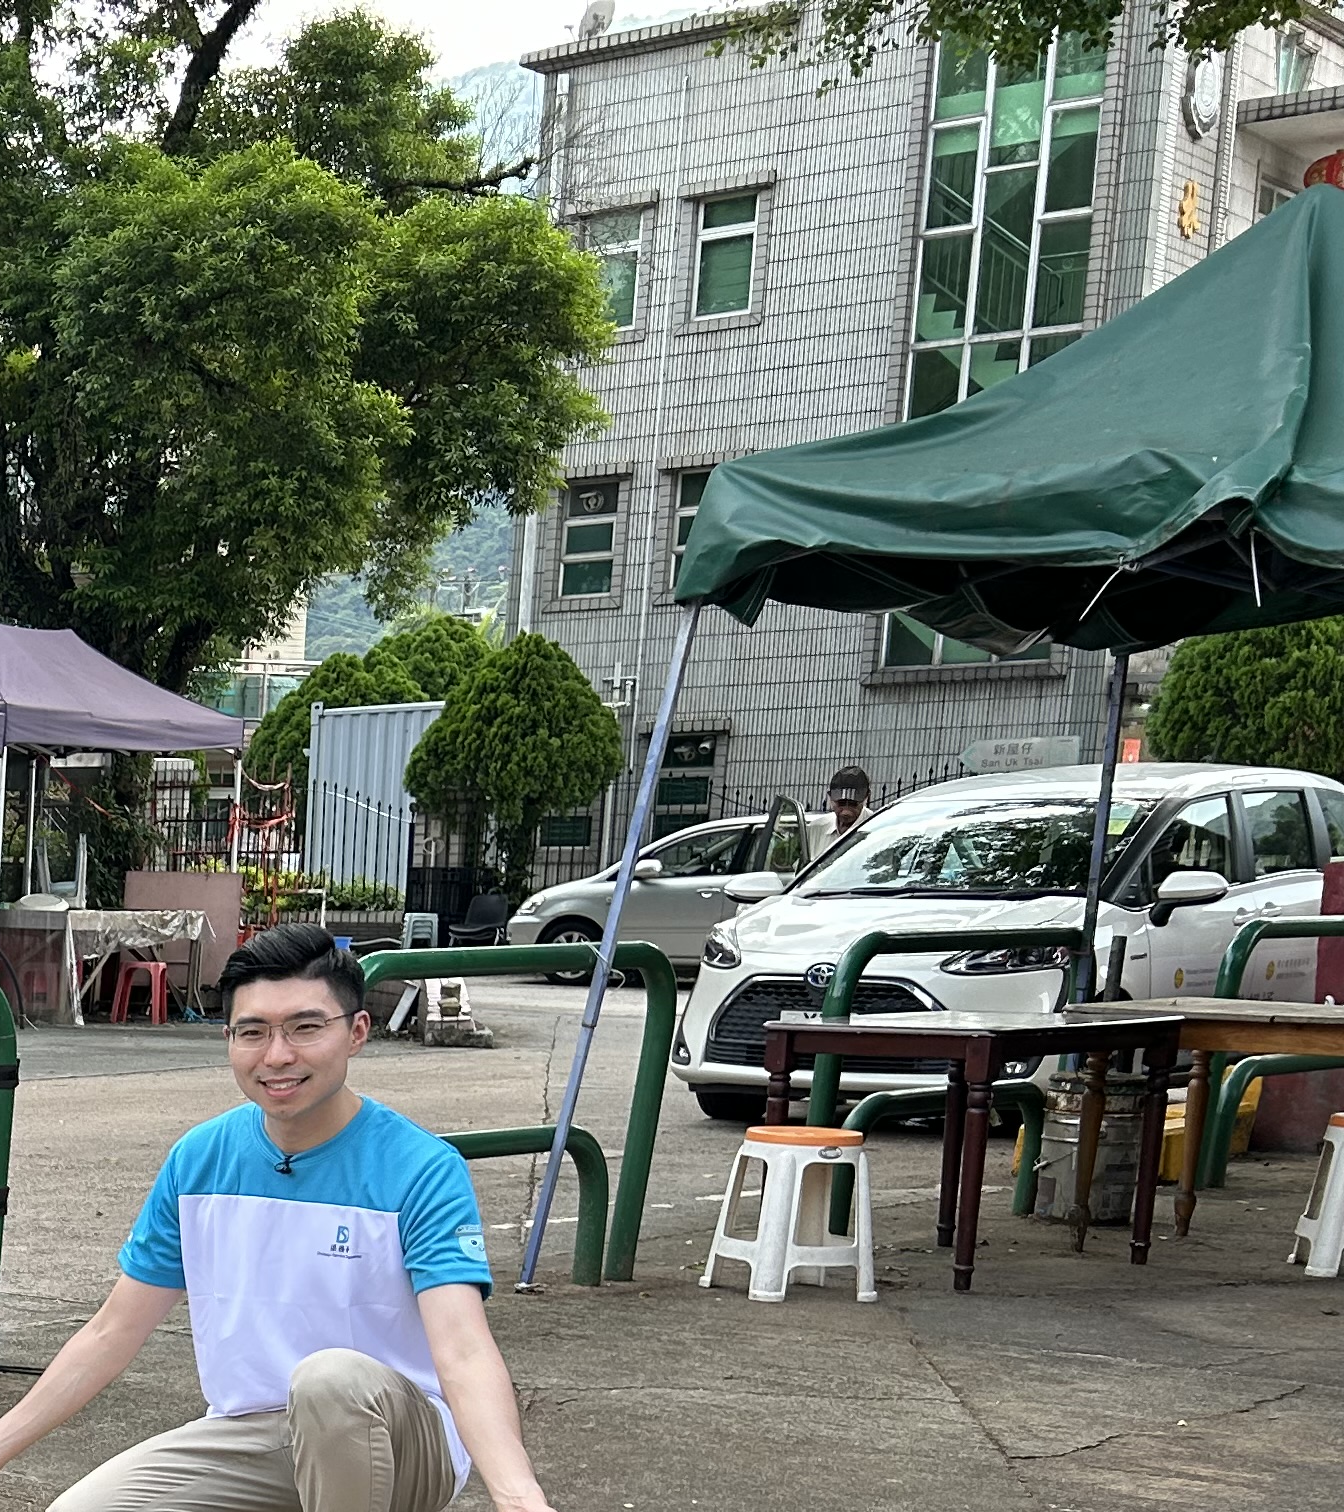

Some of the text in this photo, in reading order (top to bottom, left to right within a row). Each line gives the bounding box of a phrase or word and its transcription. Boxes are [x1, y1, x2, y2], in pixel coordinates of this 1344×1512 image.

[993, 742, 1033, 756] 新屋仔
[981, 755, 1043, 769] San Uk Tsai
